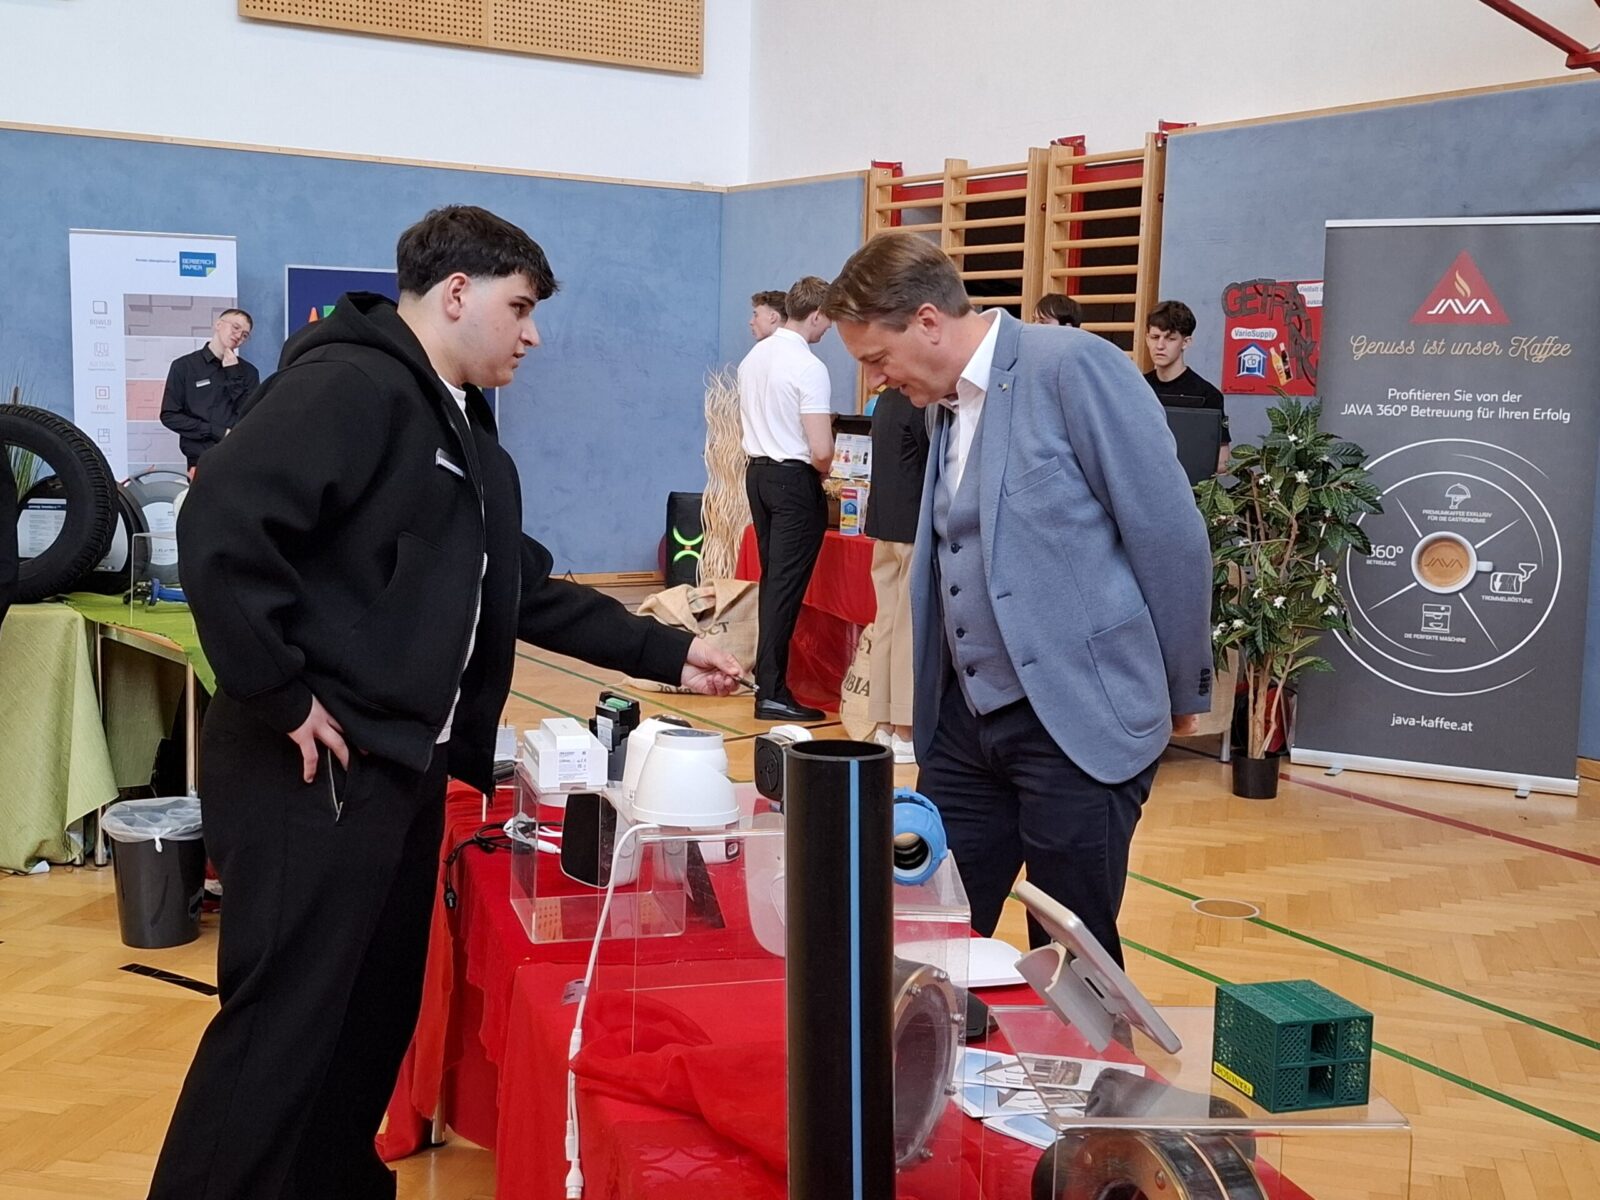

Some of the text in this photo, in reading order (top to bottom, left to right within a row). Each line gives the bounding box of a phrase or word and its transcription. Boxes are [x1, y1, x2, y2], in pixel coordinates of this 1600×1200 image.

[1427, 298, 1492, 315] JAVA
[1234, 330, 1276, 339] VarioSupply
[1350, 335, 1572, 363] Genuss ist unser Kaffee
[1387, 388, 1522, 403] Profitieren Sie von der
[1341, 404, 1373, 416] JAVA
[1410, 406, 1473, 420] Betreuung
[1477, 406, 1495, 419] für
[1498, 407, 1530, 420] Ihren
[1532, 408, 1571, 423] Erfolg
[1424, 557, 1464, 569] JAVA
[1390, 712, 1473, 732] java-kaffee.at
